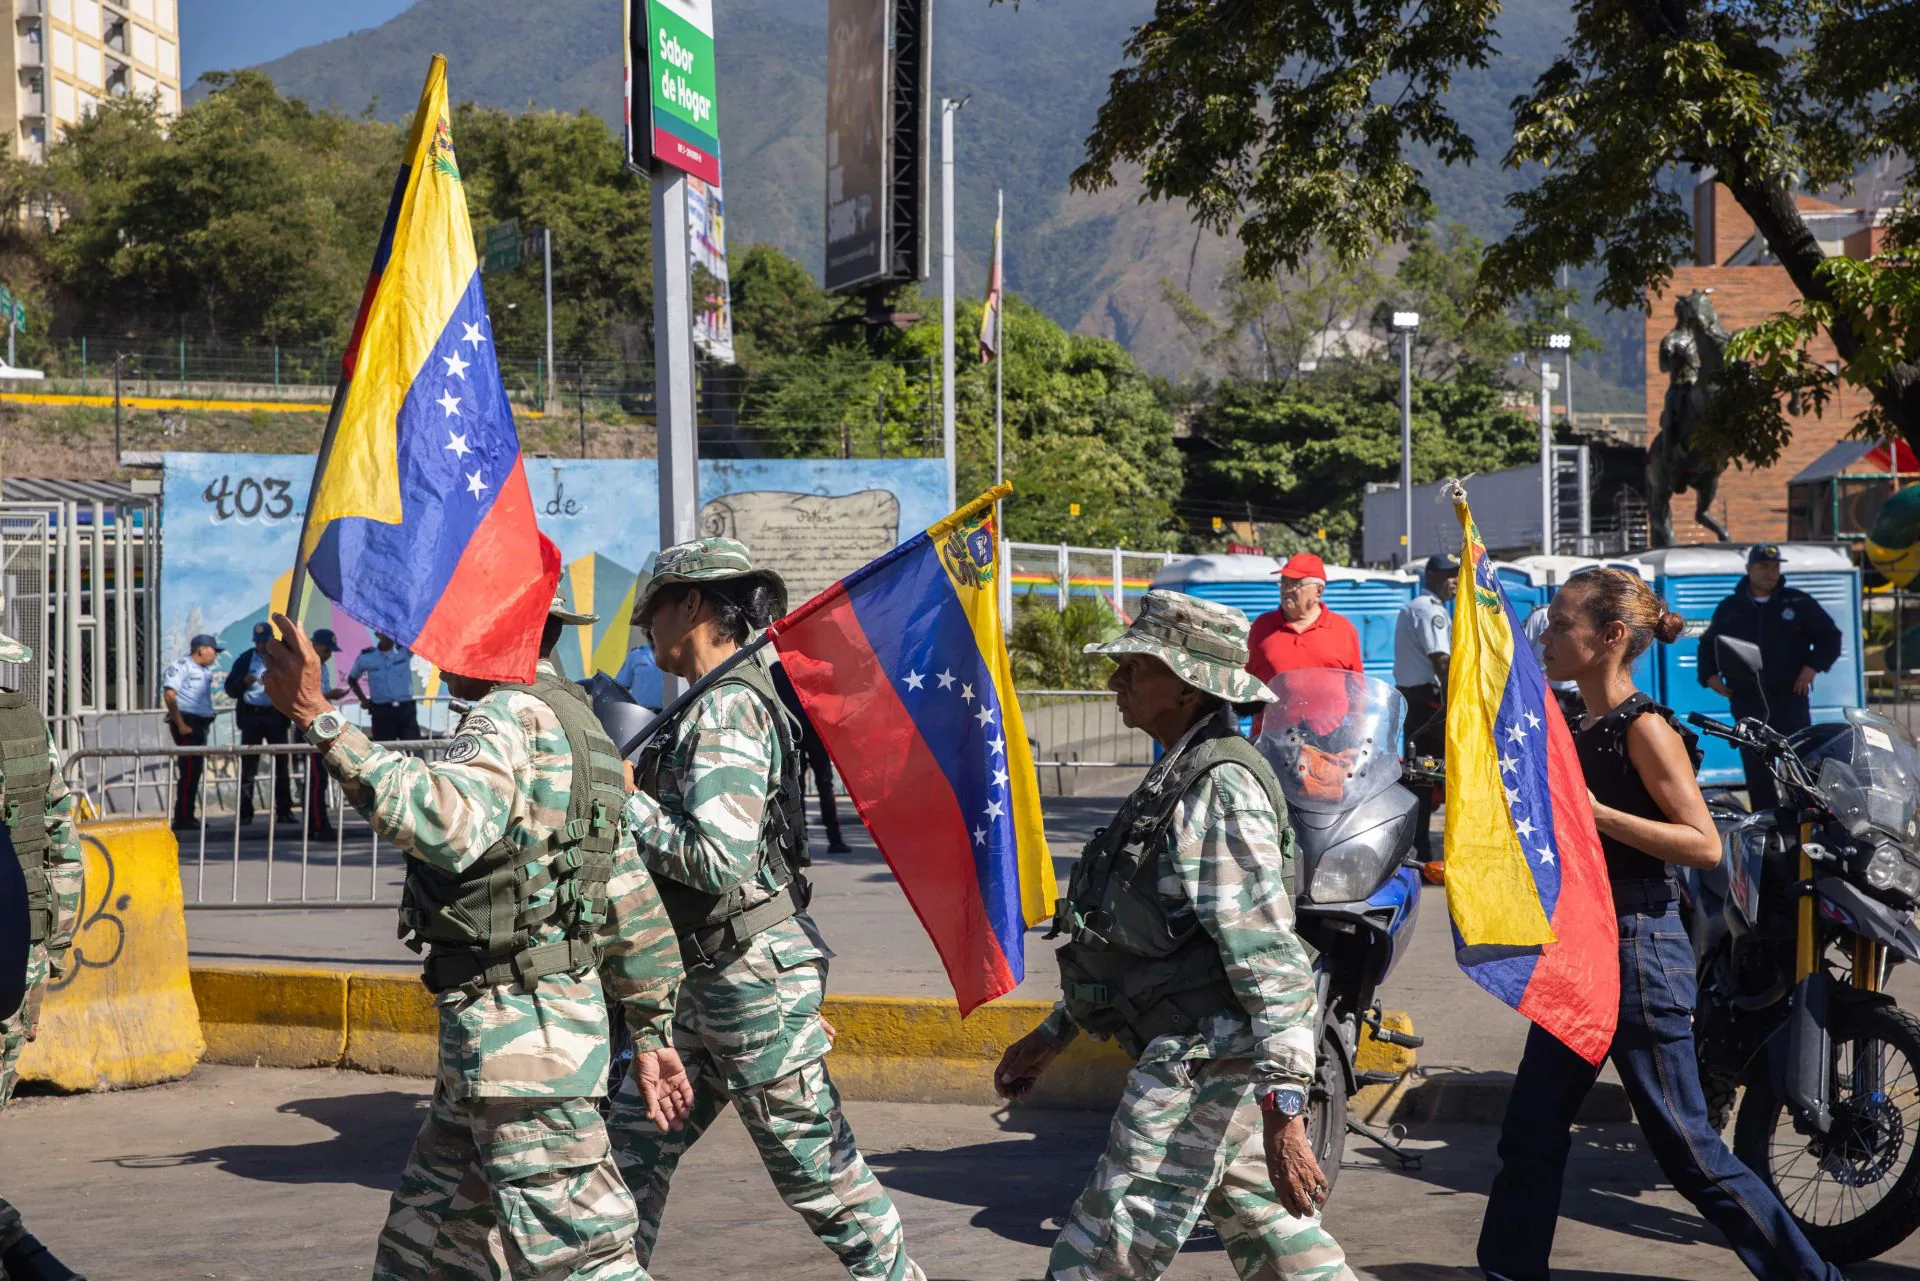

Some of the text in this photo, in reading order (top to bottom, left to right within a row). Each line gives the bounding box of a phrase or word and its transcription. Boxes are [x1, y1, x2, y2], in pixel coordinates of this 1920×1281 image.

[659, 28, 693, 74] Sabor
[661, 69, 711, 121] de Hogar
[542, 482, 581, 516] de
